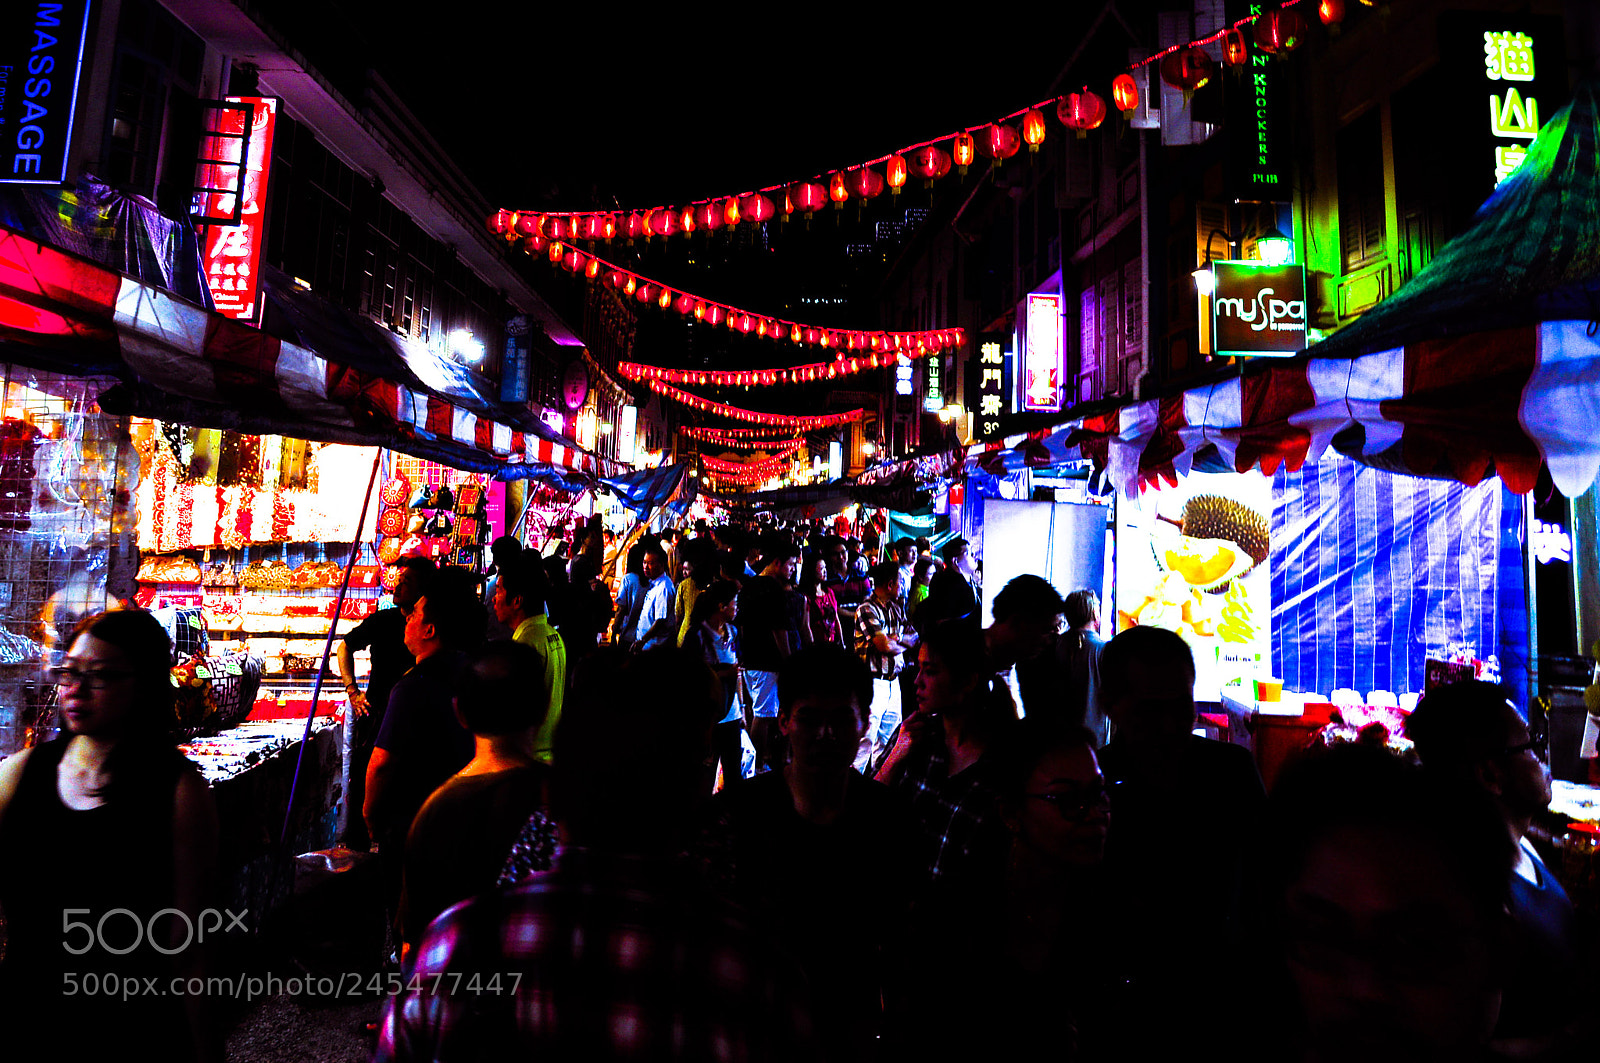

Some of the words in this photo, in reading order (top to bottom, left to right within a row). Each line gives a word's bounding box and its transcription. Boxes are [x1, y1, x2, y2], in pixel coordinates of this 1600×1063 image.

[13, 3, 63, 174] MASSAGE
[1253, 73, 1268, 165] KNOCKERS
[1252, 173, 1278, 184] PUB
[1216, 287, 1305, 331] mySpa
